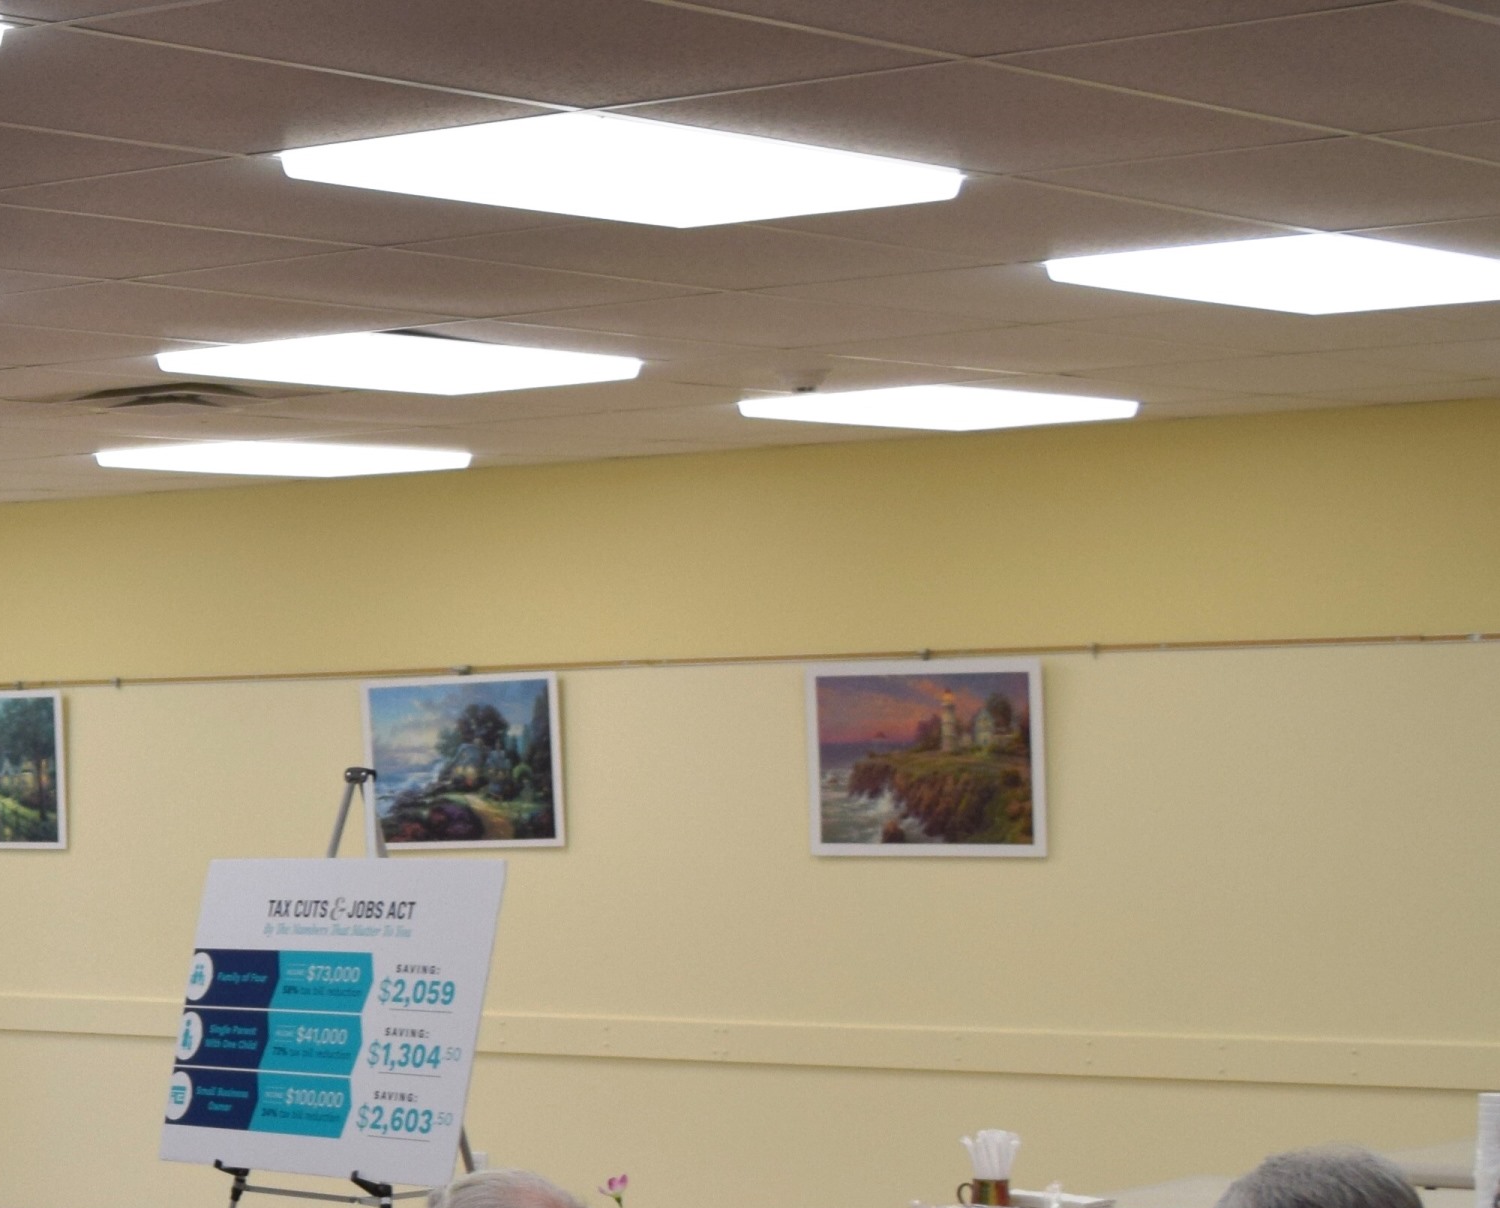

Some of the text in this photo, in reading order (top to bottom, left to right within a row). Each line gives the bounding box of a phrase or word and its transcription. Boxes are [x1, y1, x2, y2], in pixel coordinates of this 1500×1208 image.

[267, 899, 292, 918] TAX
[294, 899, 329, 919] CUTS
[347, 900, 385, 920] JOBS
[388, 901, 417, 920] ACT
[306, 964, 361, 984] $73,000
[395, 964, 441, 976] SAVING:
[379, 978, 456, 1006] $2,059
[385, 1027, 430, 1040] SAVING:
[374, 1090, 419, 1103] SAVING:
